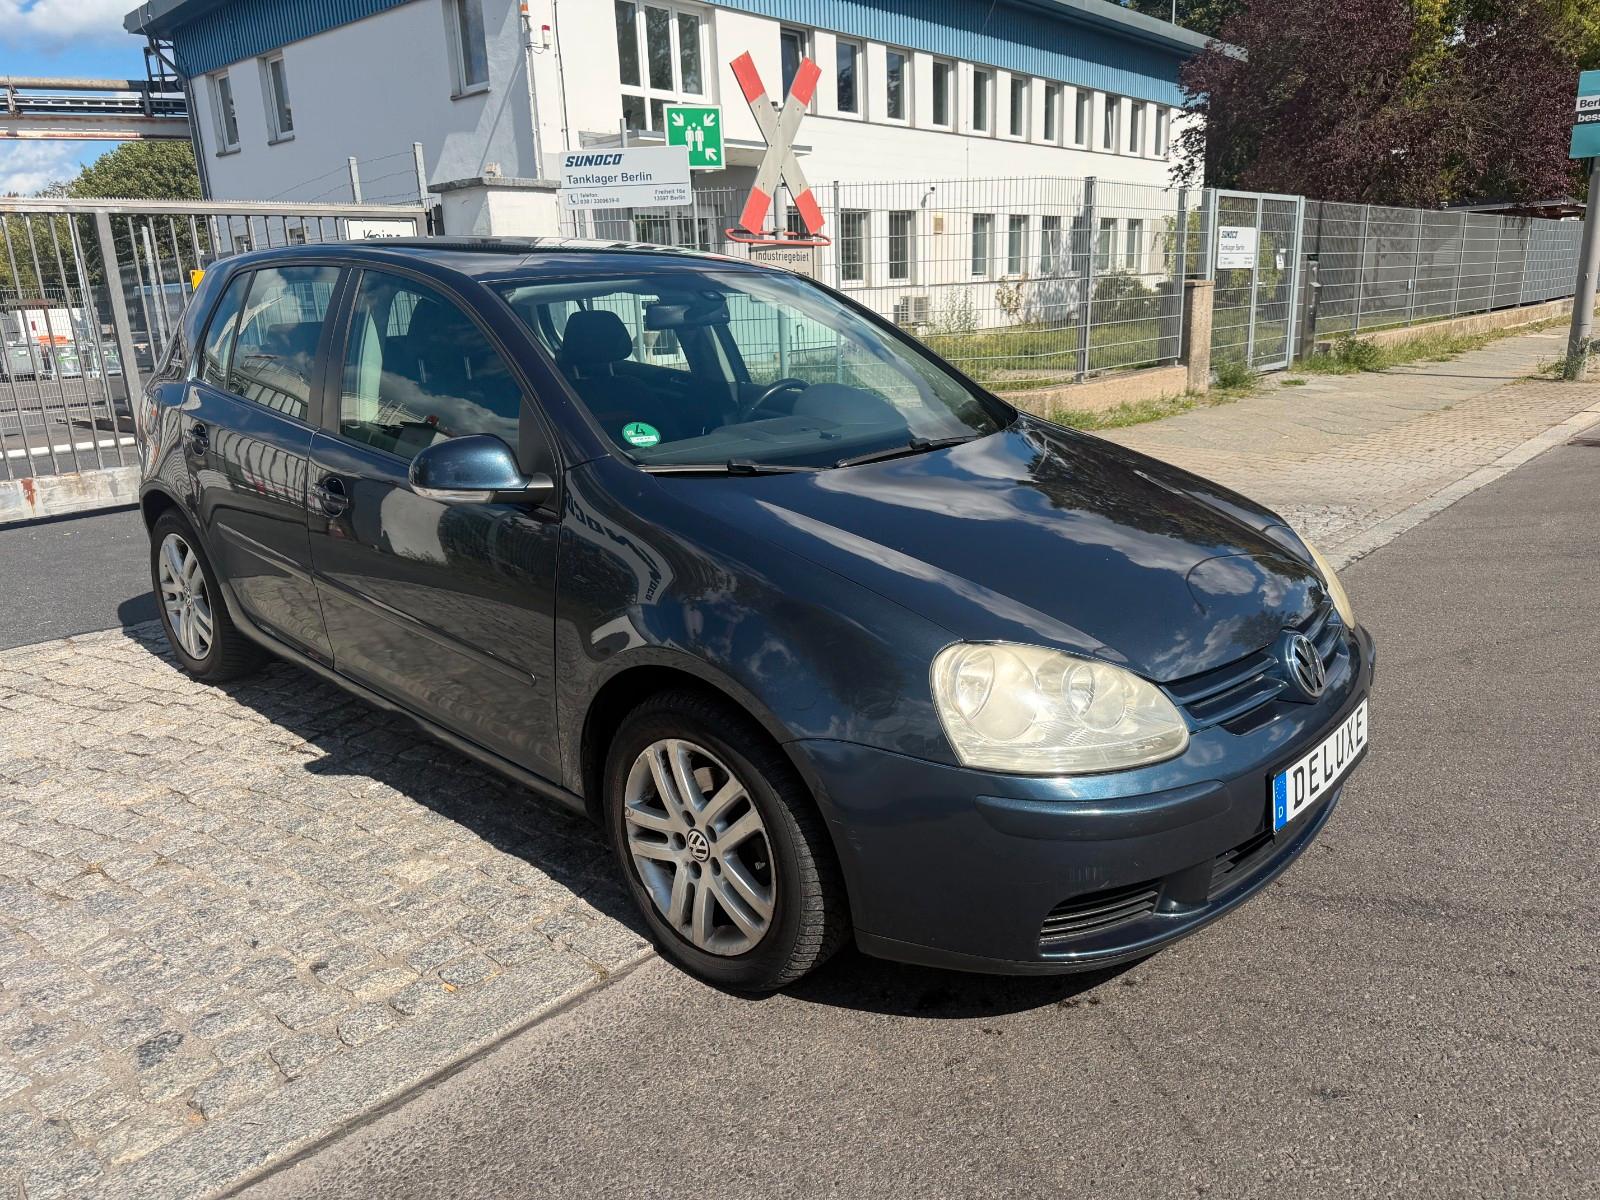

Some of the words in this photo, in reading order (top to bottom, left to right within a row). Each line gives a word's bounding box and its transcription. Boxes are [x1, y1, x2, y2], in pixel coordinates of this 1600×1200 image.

[565, 153, 623, 168] SUNOCO
[566, 173, 618, 186] Tanklager
[621, 171, 653, 182] Berlin
[755, 249, 808, 263] Industriegebiet
[635, 424, 645, 435] 4
[1293, 707, 1363, 810] DELUXE
[1278, 805, 1284, 820] D
